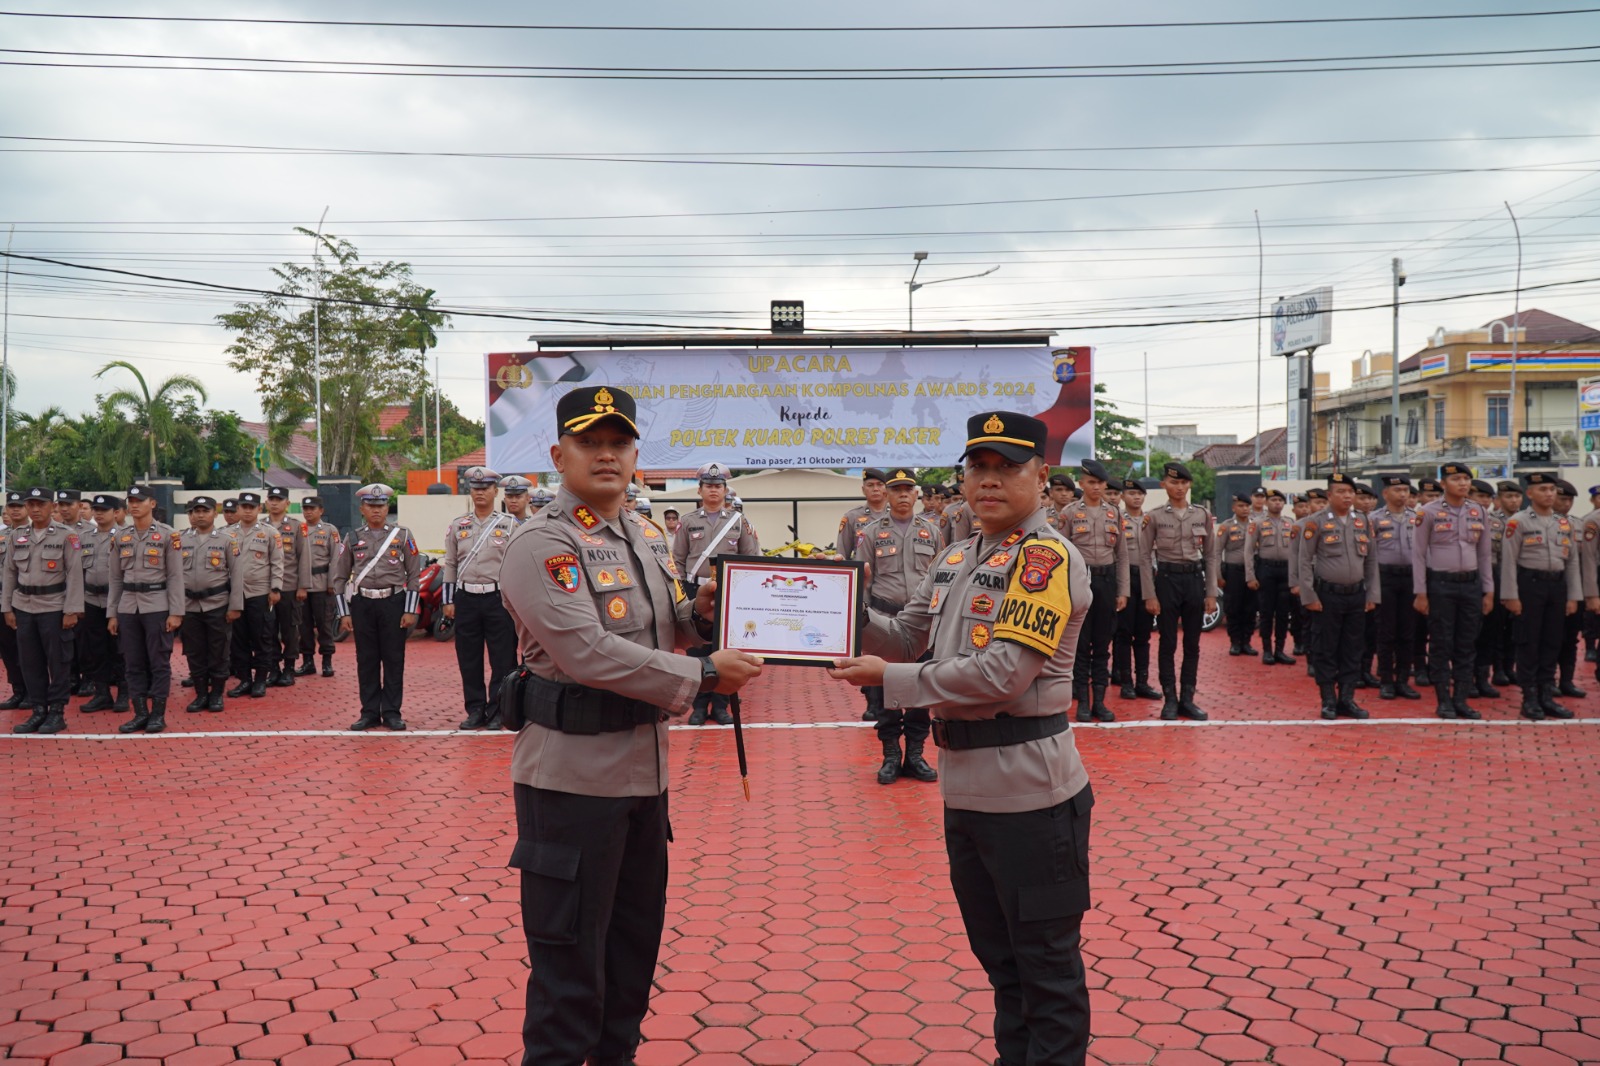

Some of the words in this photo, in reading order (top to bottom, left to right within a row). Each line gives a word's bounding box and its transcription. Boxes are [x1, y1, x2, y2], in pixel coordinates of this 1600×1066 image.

[748, 354, 852, 373] UPACARA
[669, 383, 798, 399] PENGHARGAAN
[801, 382, 910, 398] KOMPOLNAS
[914, 382, 988, 397] AWARDS
[993, 382, 1036, 396] 2024
[780, 405, 832, 426] Kepada
[670, 429, 739, 447] POLSEK
[743, 428, 805, 447] KUARO
[811, 427, 879, 446] POLRES
[884, 427, 941, 446] PASER
[745, 457, 767, 465] Tana
[769, 458, 795, 467] paser,
[797, 457, 807, 465] 21
[809, 456, 844, 465] Oktober
[847, 456, 866, 465] 2024
[913, 537, 934, 546] POLRI
[587, 548, 620, 562] NOVY
[650, 544, 669, 556] POLR
[548, 556, 574, 565] PROPAM
[972, 572, 1005, 590] POLRI
